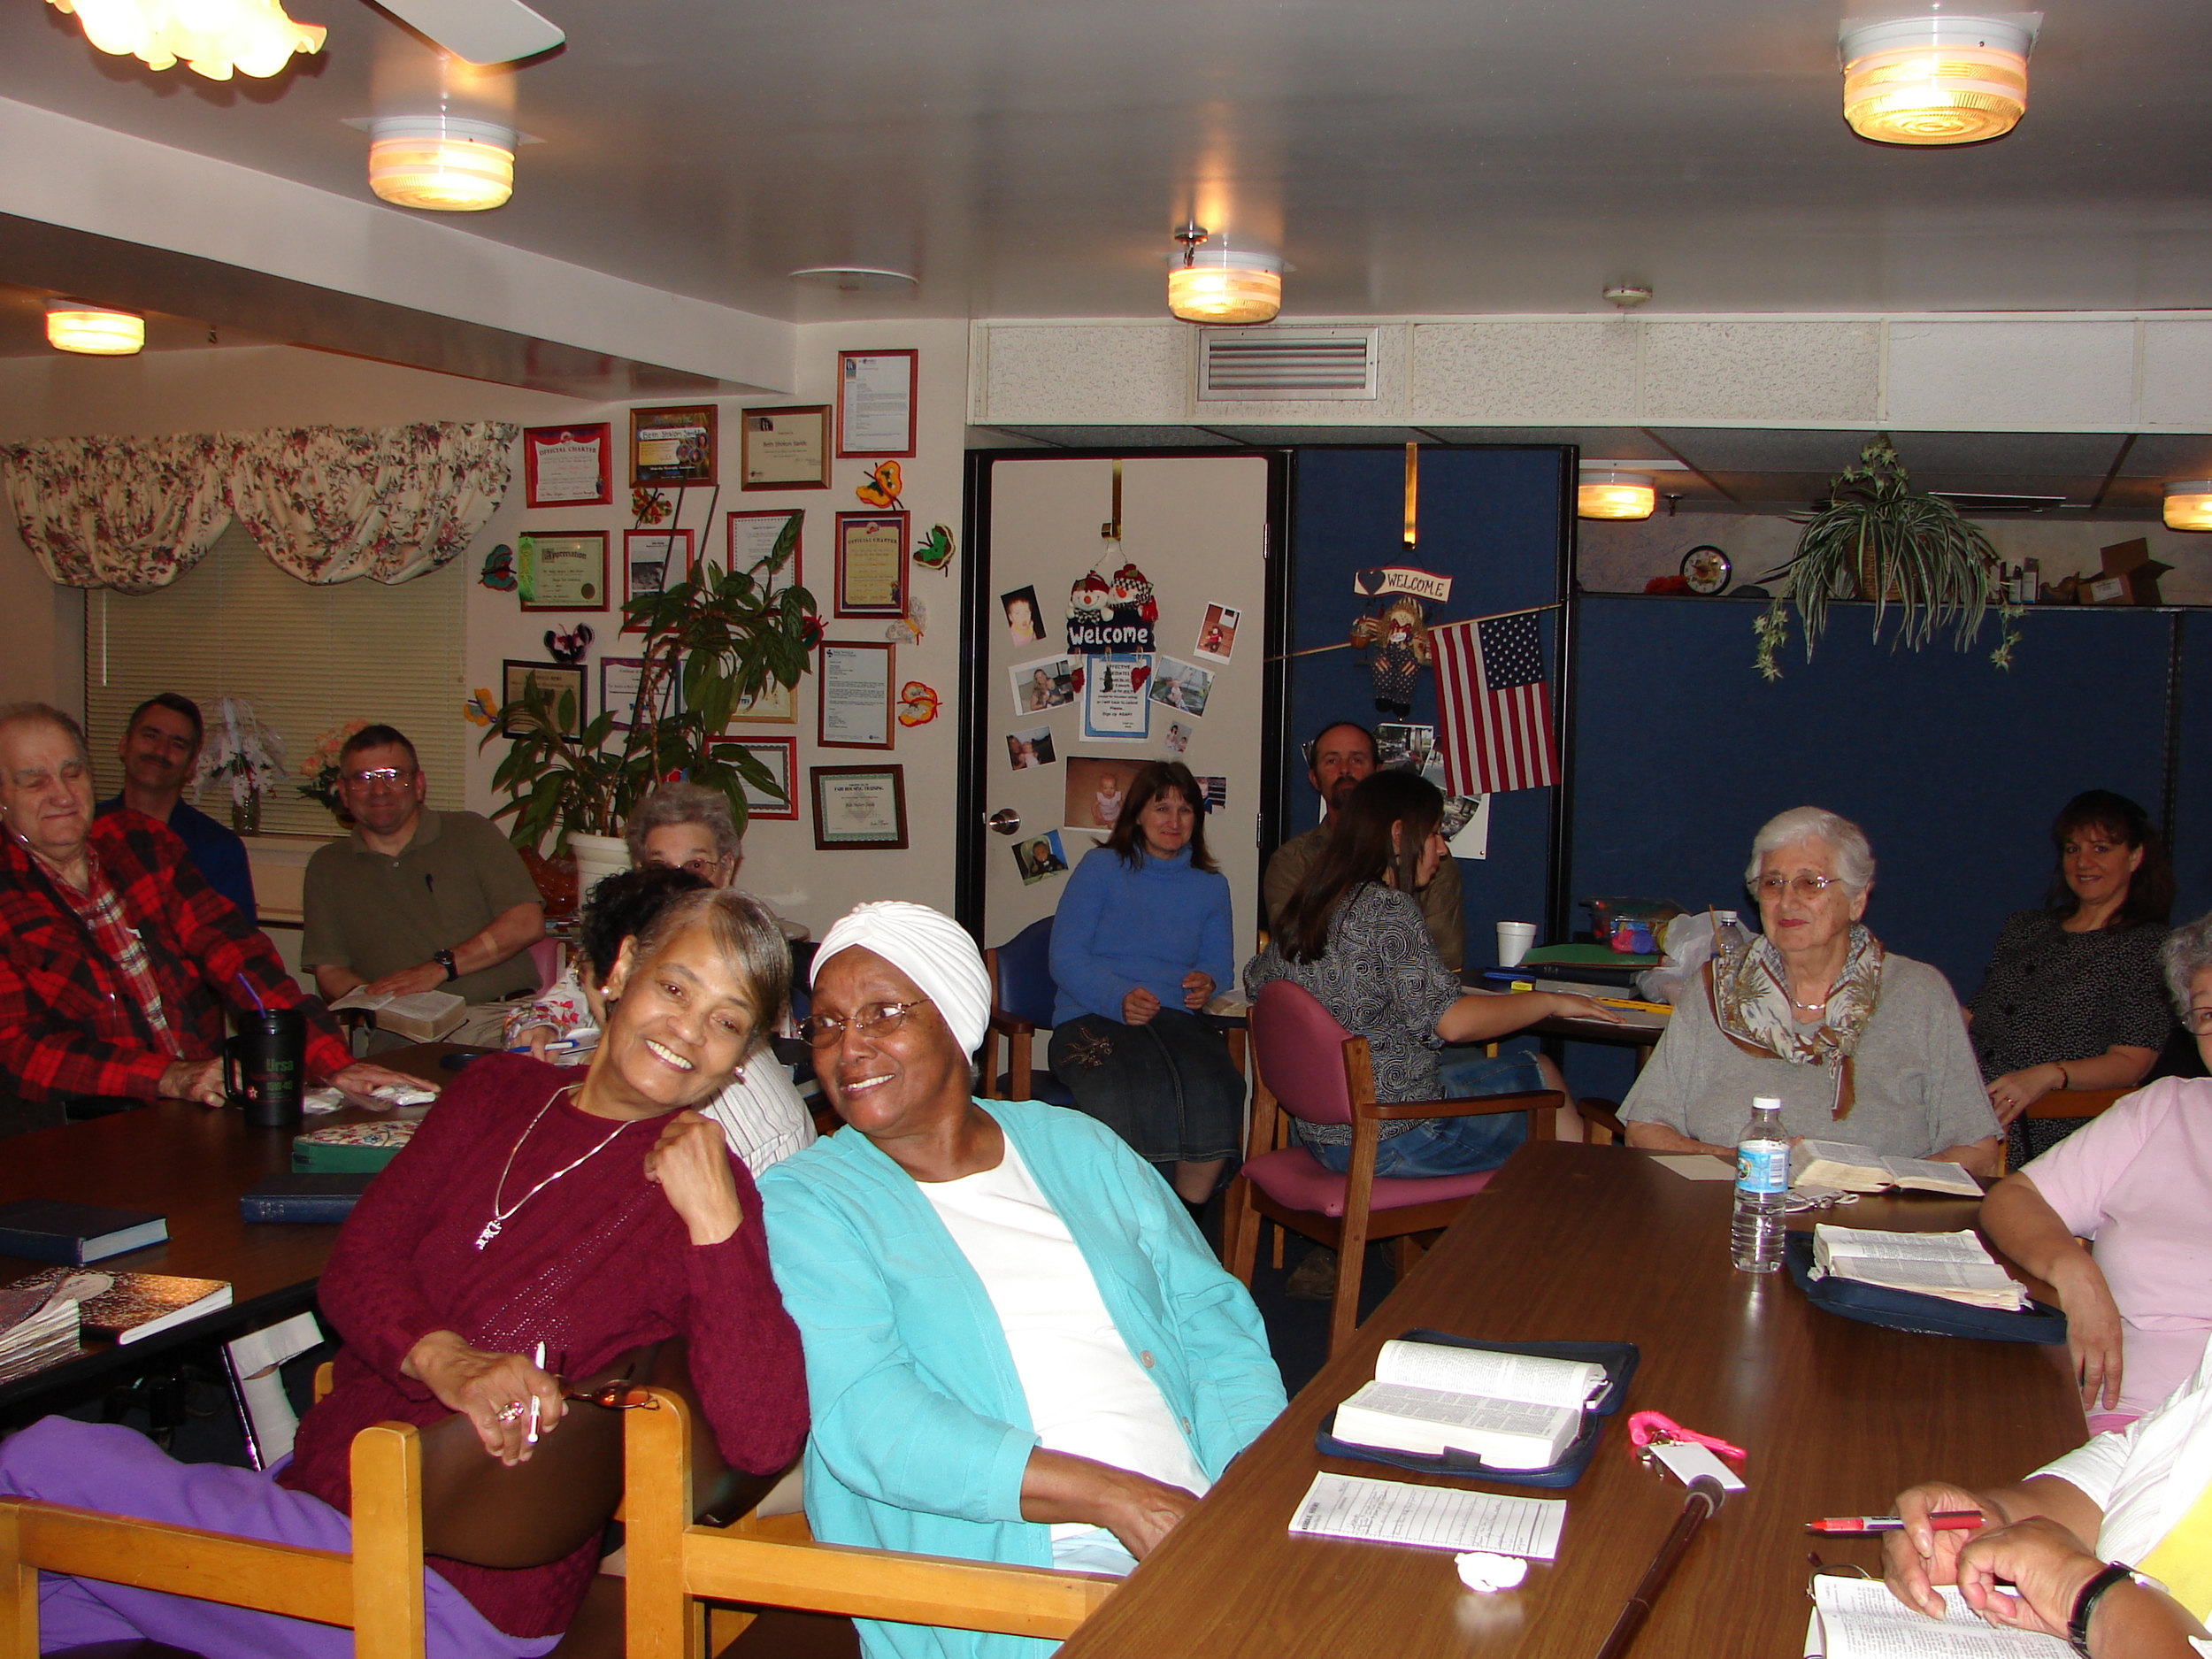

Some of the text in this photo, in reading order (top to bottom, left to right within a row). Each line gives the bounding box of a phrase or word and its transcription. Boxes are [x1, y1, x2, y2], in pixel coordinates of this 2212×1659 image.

[539, 447, 566, 456] OFFICIAL
[544, 550, 587, 560] Appreciation
[1387, 573, 1444, 597] WELCOME
[1069, 626, 1148, 646] Welcome
[266, 1057, 294, 1071] Ursa
